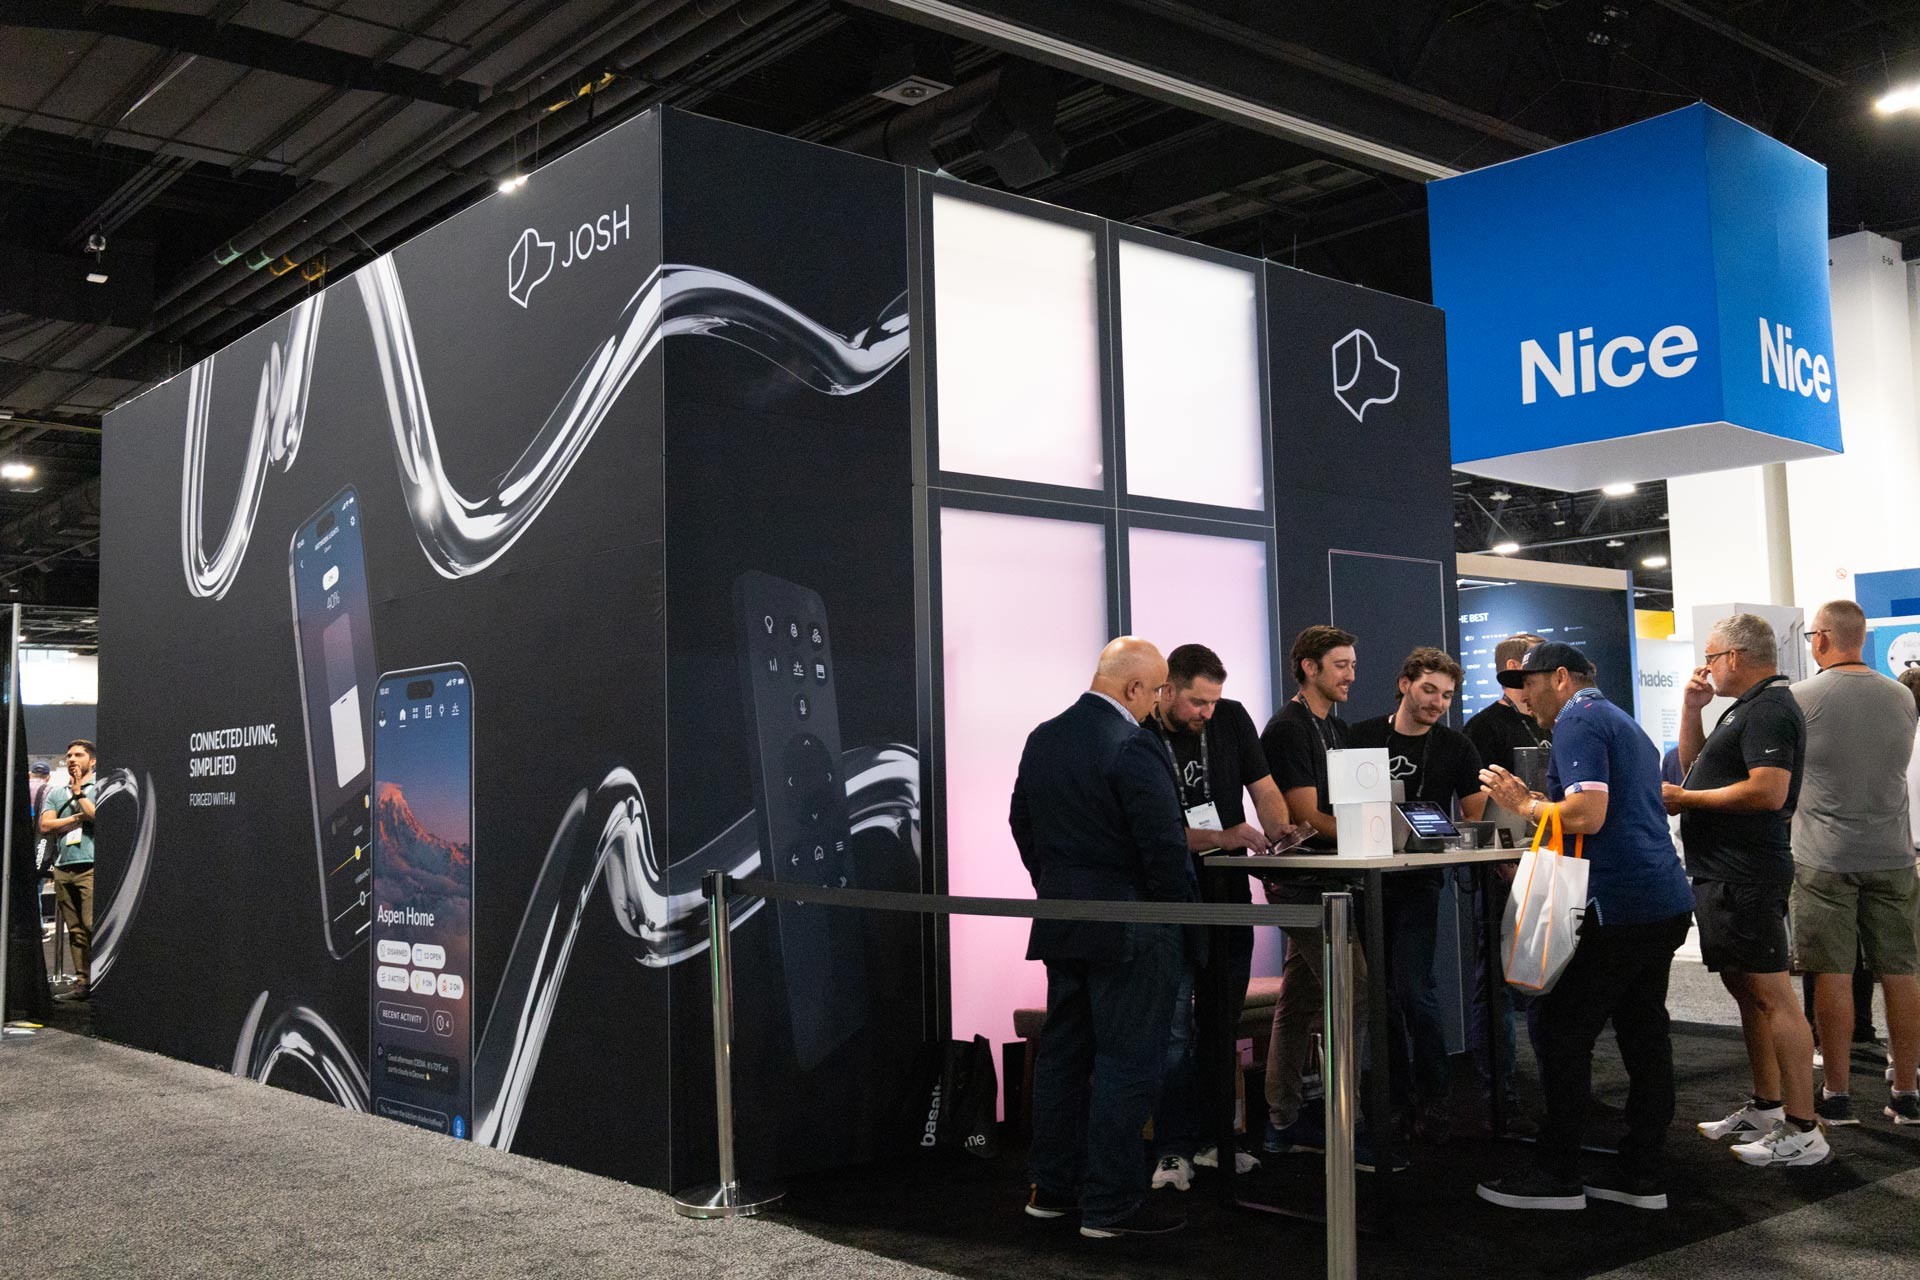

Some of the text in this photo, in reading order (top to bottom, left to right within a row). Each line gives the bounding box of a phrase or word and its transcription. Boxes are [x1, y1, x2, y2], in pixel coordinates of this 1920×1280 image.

[561, 203, 630, 268] JOSH
[1520, 325, 1699, 405] Nice
[1759, 317, 1831, 404] Nice
[1458, 612, 1489, 624] HE BEST
[1639, 669, 1673, 688] hades
[189, 723, 278, 752] CONNECTED LIVING,
[189, 755, 237, 778] SIMPLIFIED
[189, 791, 236, 807] FORGED WITH AI
[377, 904, 435, 927] Aspen Home
[382, 1009, 423, 1024] RECENT ACTIVITY
